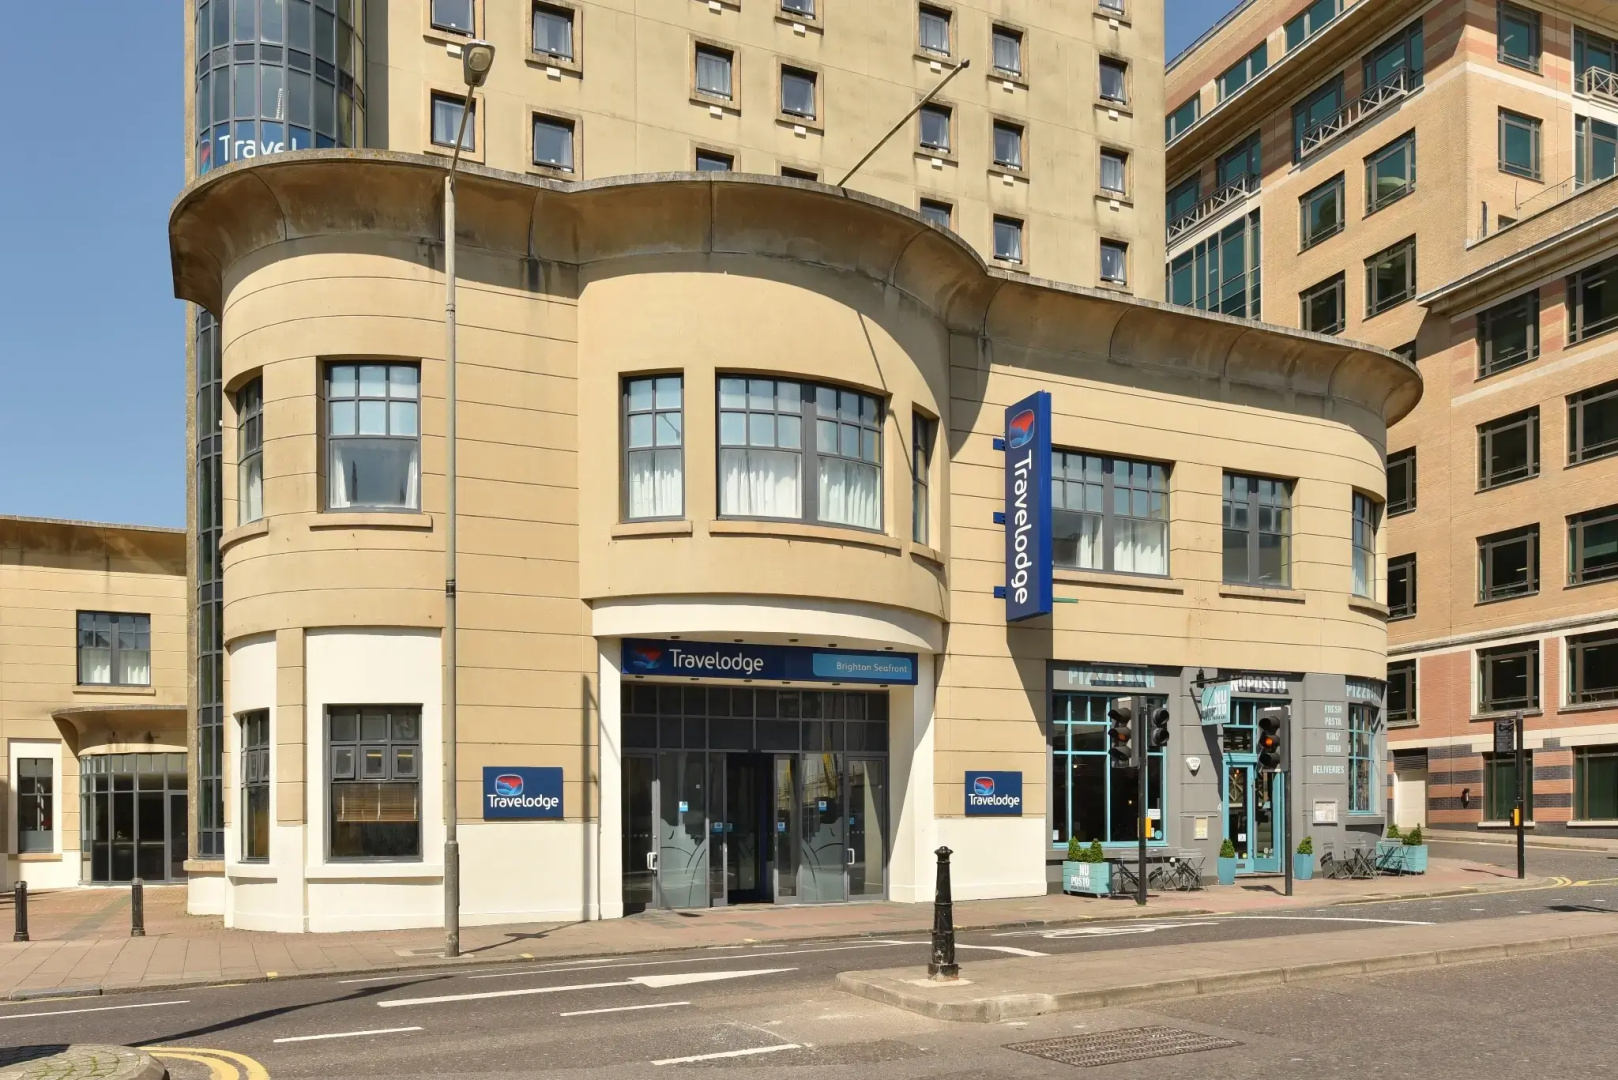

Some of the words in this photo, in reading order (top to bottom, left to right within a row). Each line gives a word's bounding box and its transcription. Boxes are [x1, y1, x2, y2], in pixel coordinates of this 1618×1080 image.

[1011, 449, 1033, 604] Travelodge
[668, 648, 764, 675] Travelodge
[836, 661, 872, 673] Brighton
[873, 663, 908, 673] Seafront
[1324, 704, 1342, 714] FRESH
[1324, 717, 1342, 726] PASTA
[1325, 744, 1342, 753] MENU
[1312, 765, 1345, 774] DELIVERIES
[486, 794, 559, 810] Travelodge
[968, 793, 1020, 808] Travelodge
[1079, 864, 1090, 876] NU
[1070, 876, 1090, 887] POSTO
